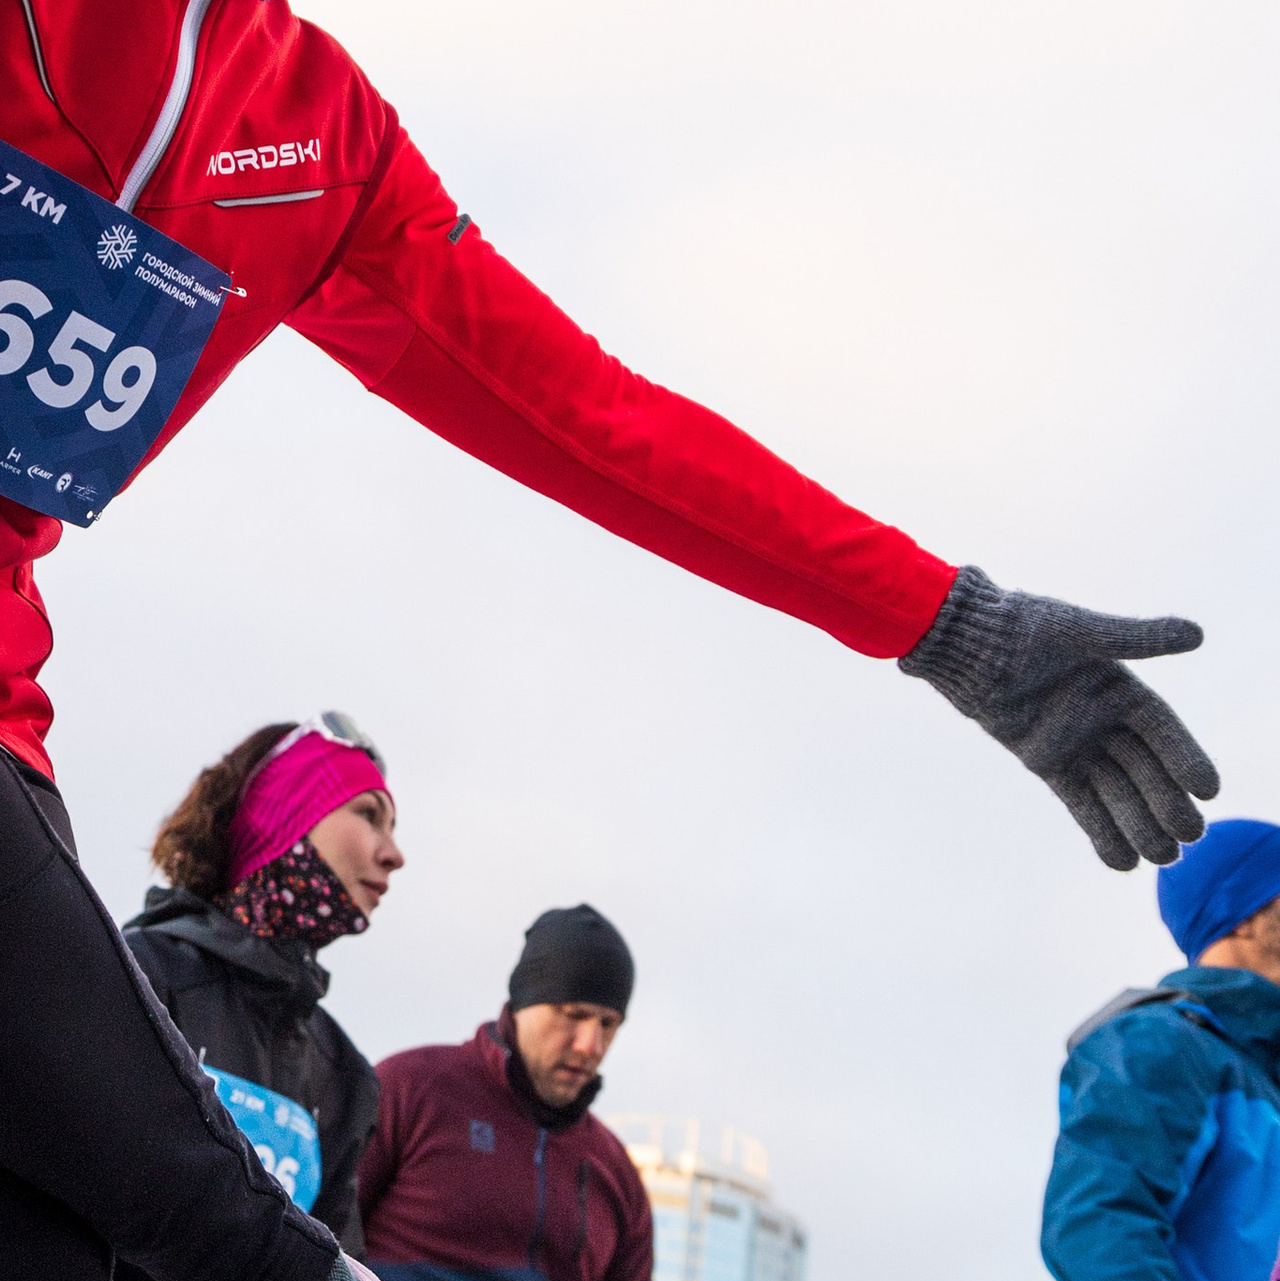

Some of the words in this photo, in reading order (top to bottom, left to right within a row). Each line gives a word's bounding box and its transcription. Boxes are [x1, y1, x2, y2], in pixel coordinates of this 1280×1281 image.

[206, 138, 320, 176] NORDSKI
[0, 173, 22, 195] 7
[135, 265, 197, 308] ПОЛУМАРАФОН
[142, 252, 195, 290] ГОРОДСКОЙ
